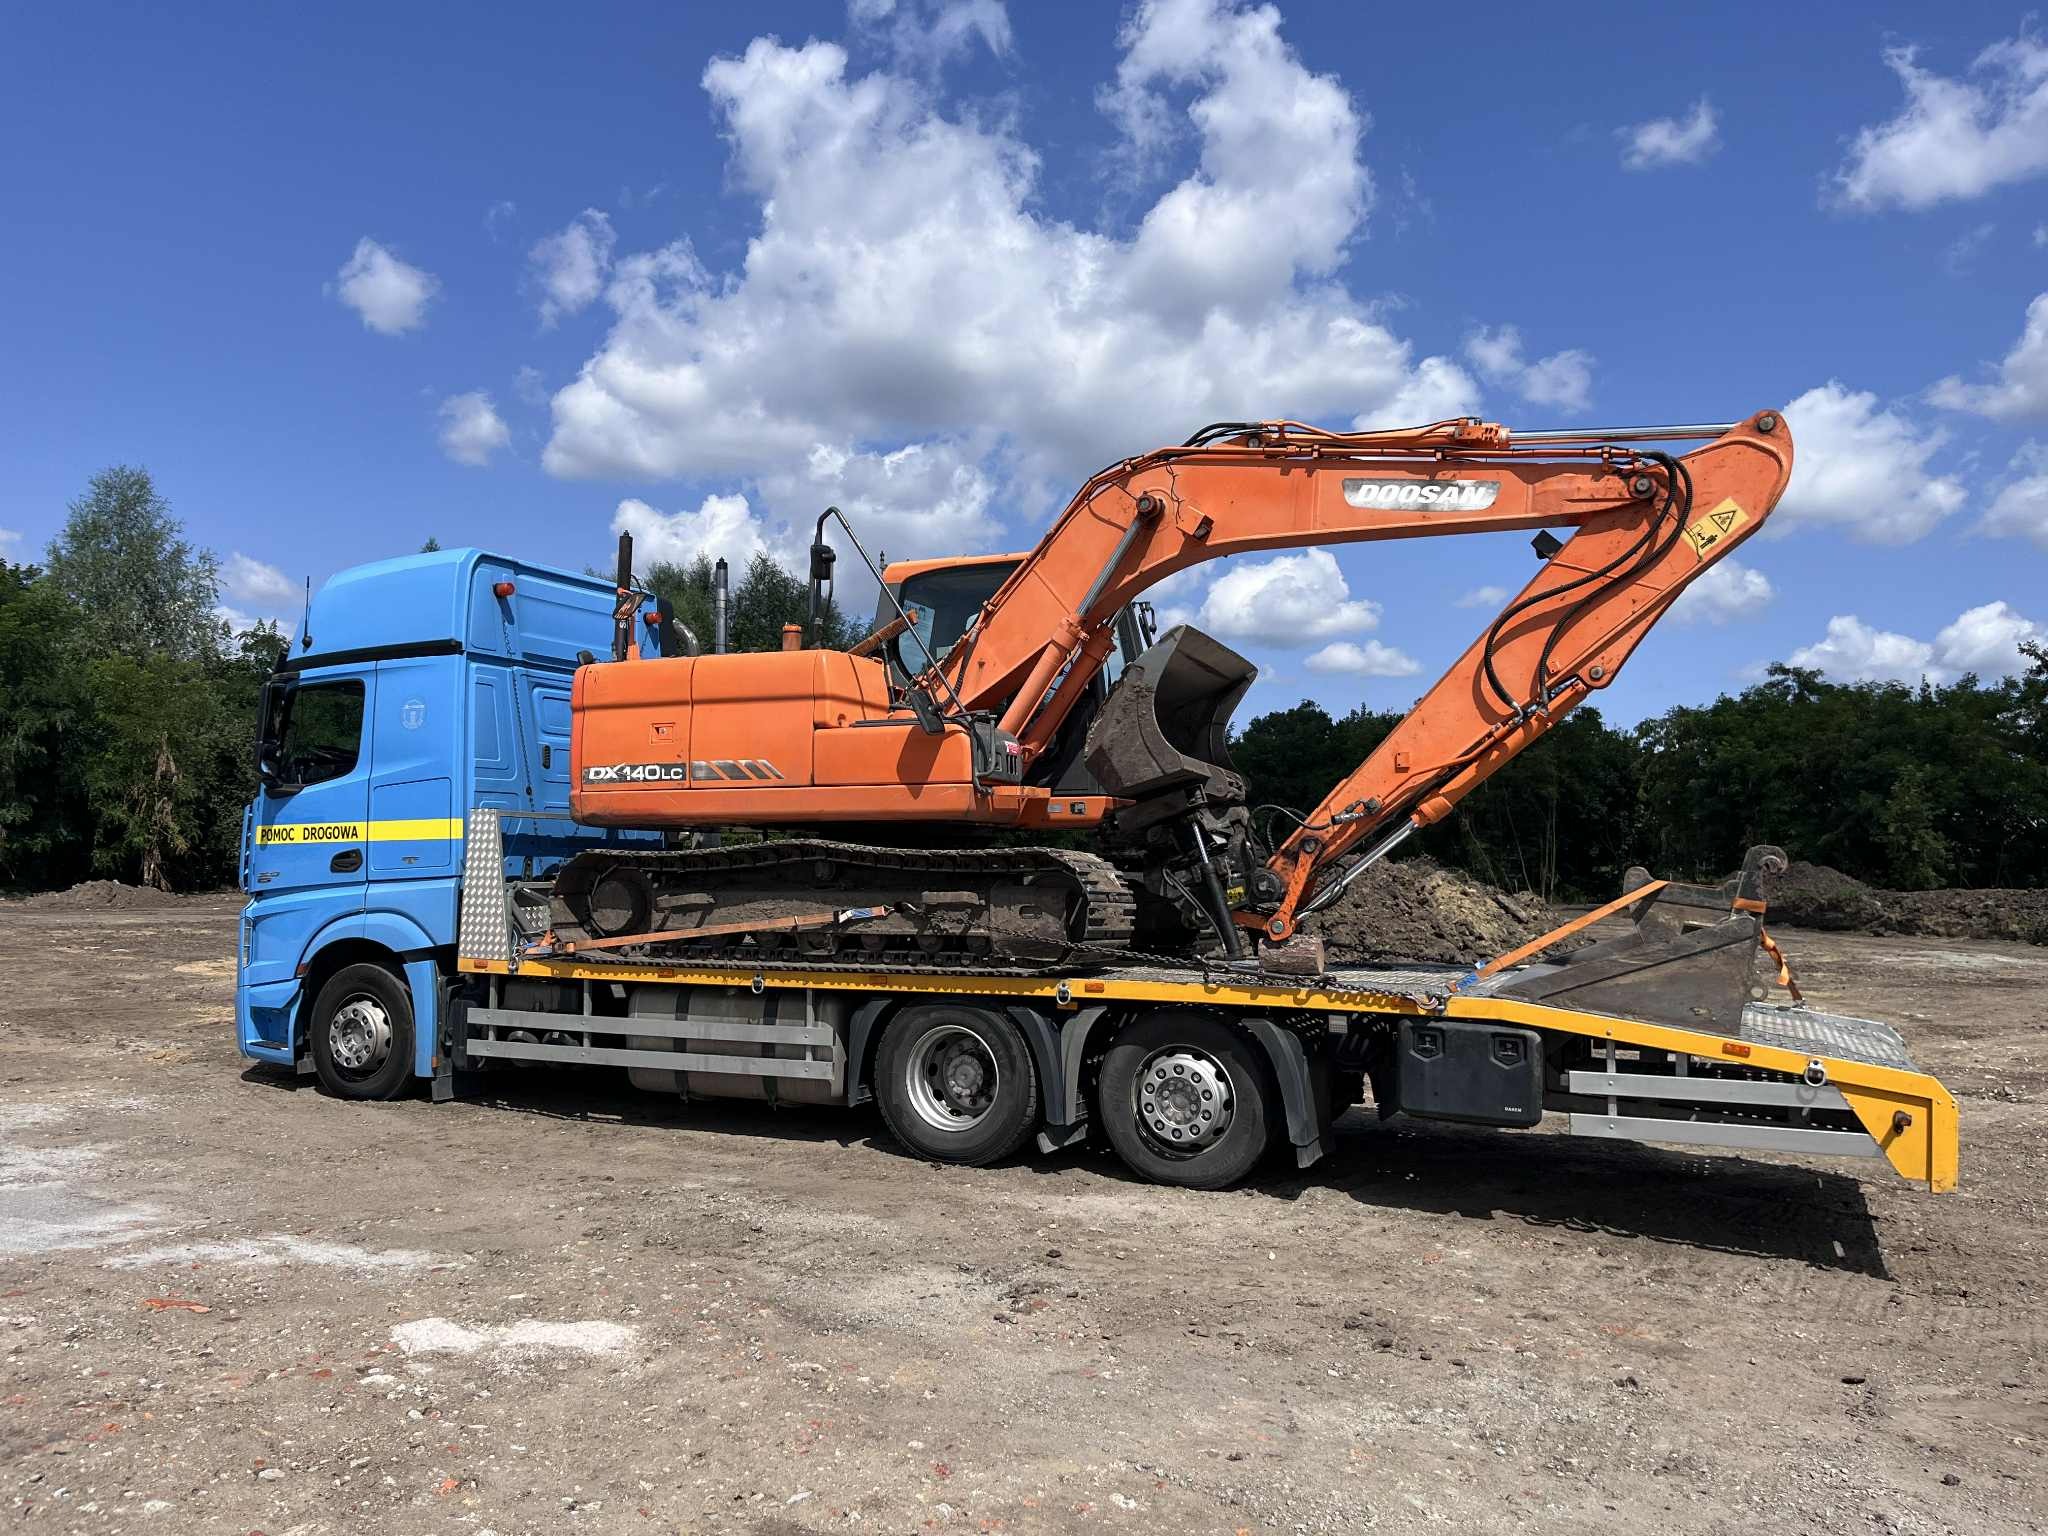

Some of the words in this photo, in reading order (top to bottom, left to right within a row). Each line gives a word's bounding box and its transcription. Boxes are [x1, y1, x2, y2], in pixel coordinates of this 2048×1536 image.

[1356, 484, 1487, 504] DOOSAN
[260, 827, 295, 842] POMOC
[303, 825, 359, 841] DROGOWA
